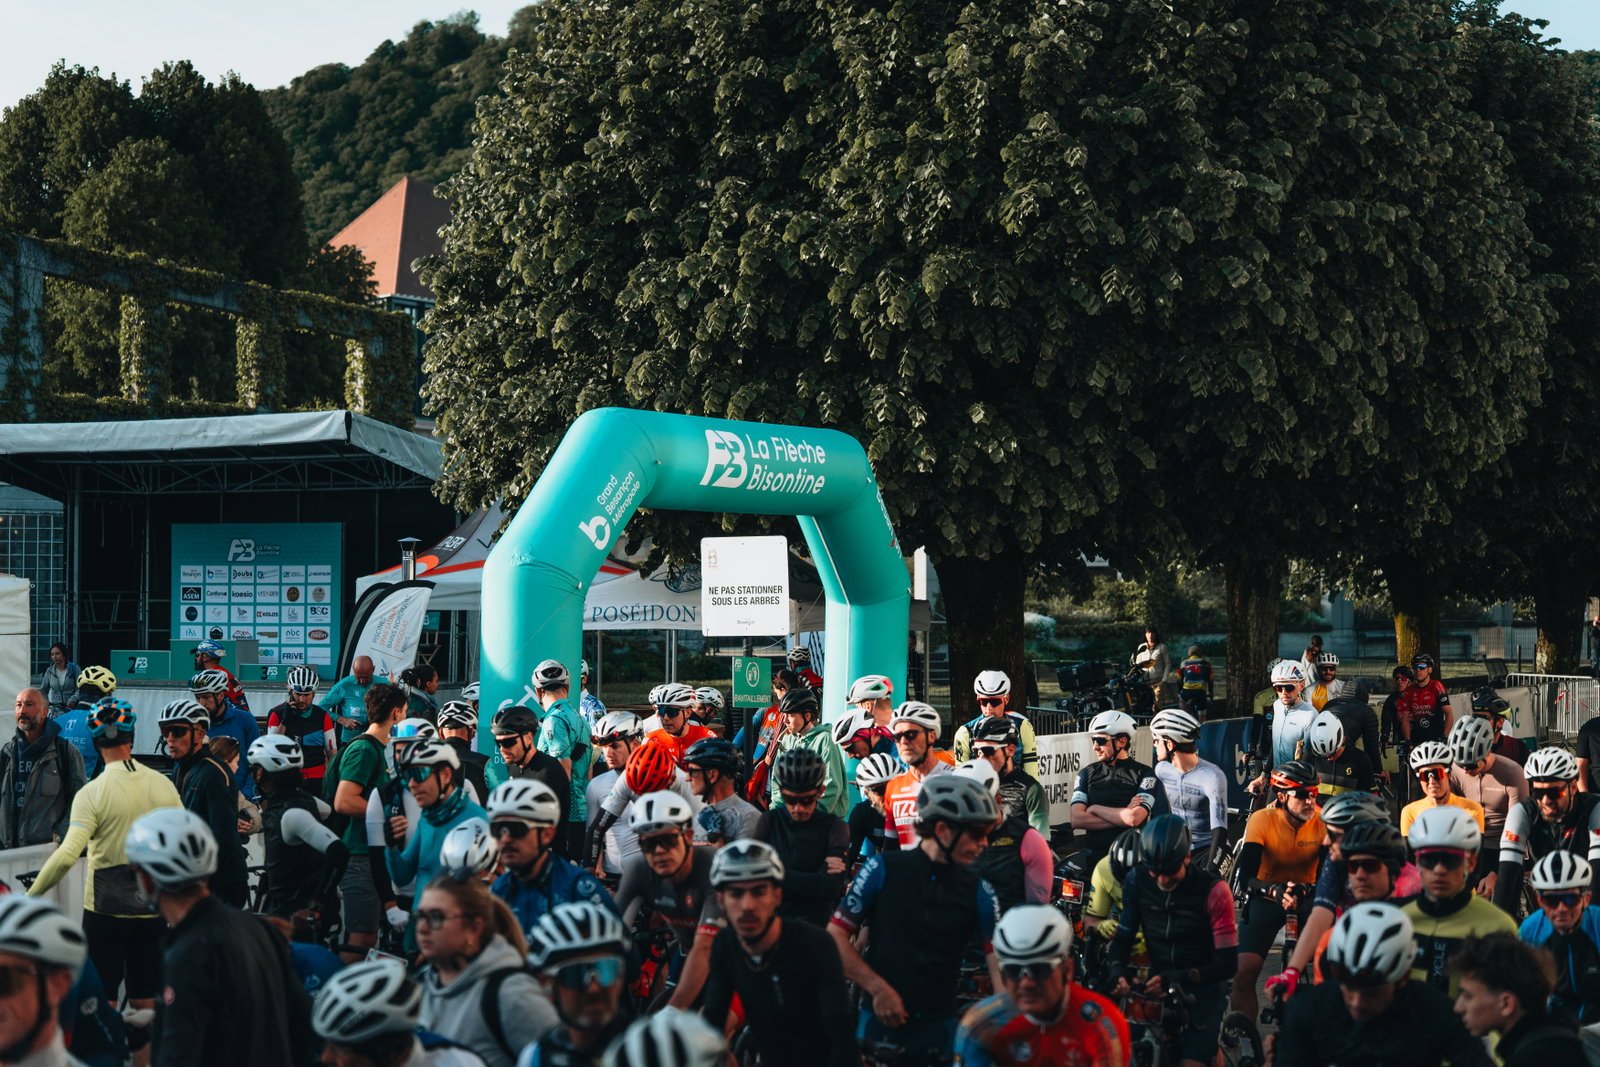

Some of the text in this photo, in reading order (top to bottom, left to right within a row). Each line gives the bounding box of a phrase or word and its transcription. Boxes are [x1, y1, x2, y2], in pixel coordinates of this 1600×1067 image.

[745, 433, 826, 464] La Flèche
[597, 474, 618, 505] Grand
[746, 464, 826, 494] Bisontine
[605, 471, 635, 515] Besançon
[612, 481, 640, 526] Métropole
[232, 590, 253, 598] koesio
[708, 585, 783, 595] NE PAS STATIONNER
[711, 596, 780, 606] SOUS LES ARBRES
[310, 606, 328, 615] BSC
[591, 603, 697, 623] POSÉIDON
[372, 617, 386, 643] PISCINES
[127, 656, 136, 674] 2
[734, 694, 771, 703] RAVITAILLEMENT
[1054, 752, 1080, 774] DANS
[852, 857, 880, 897] PARIS
